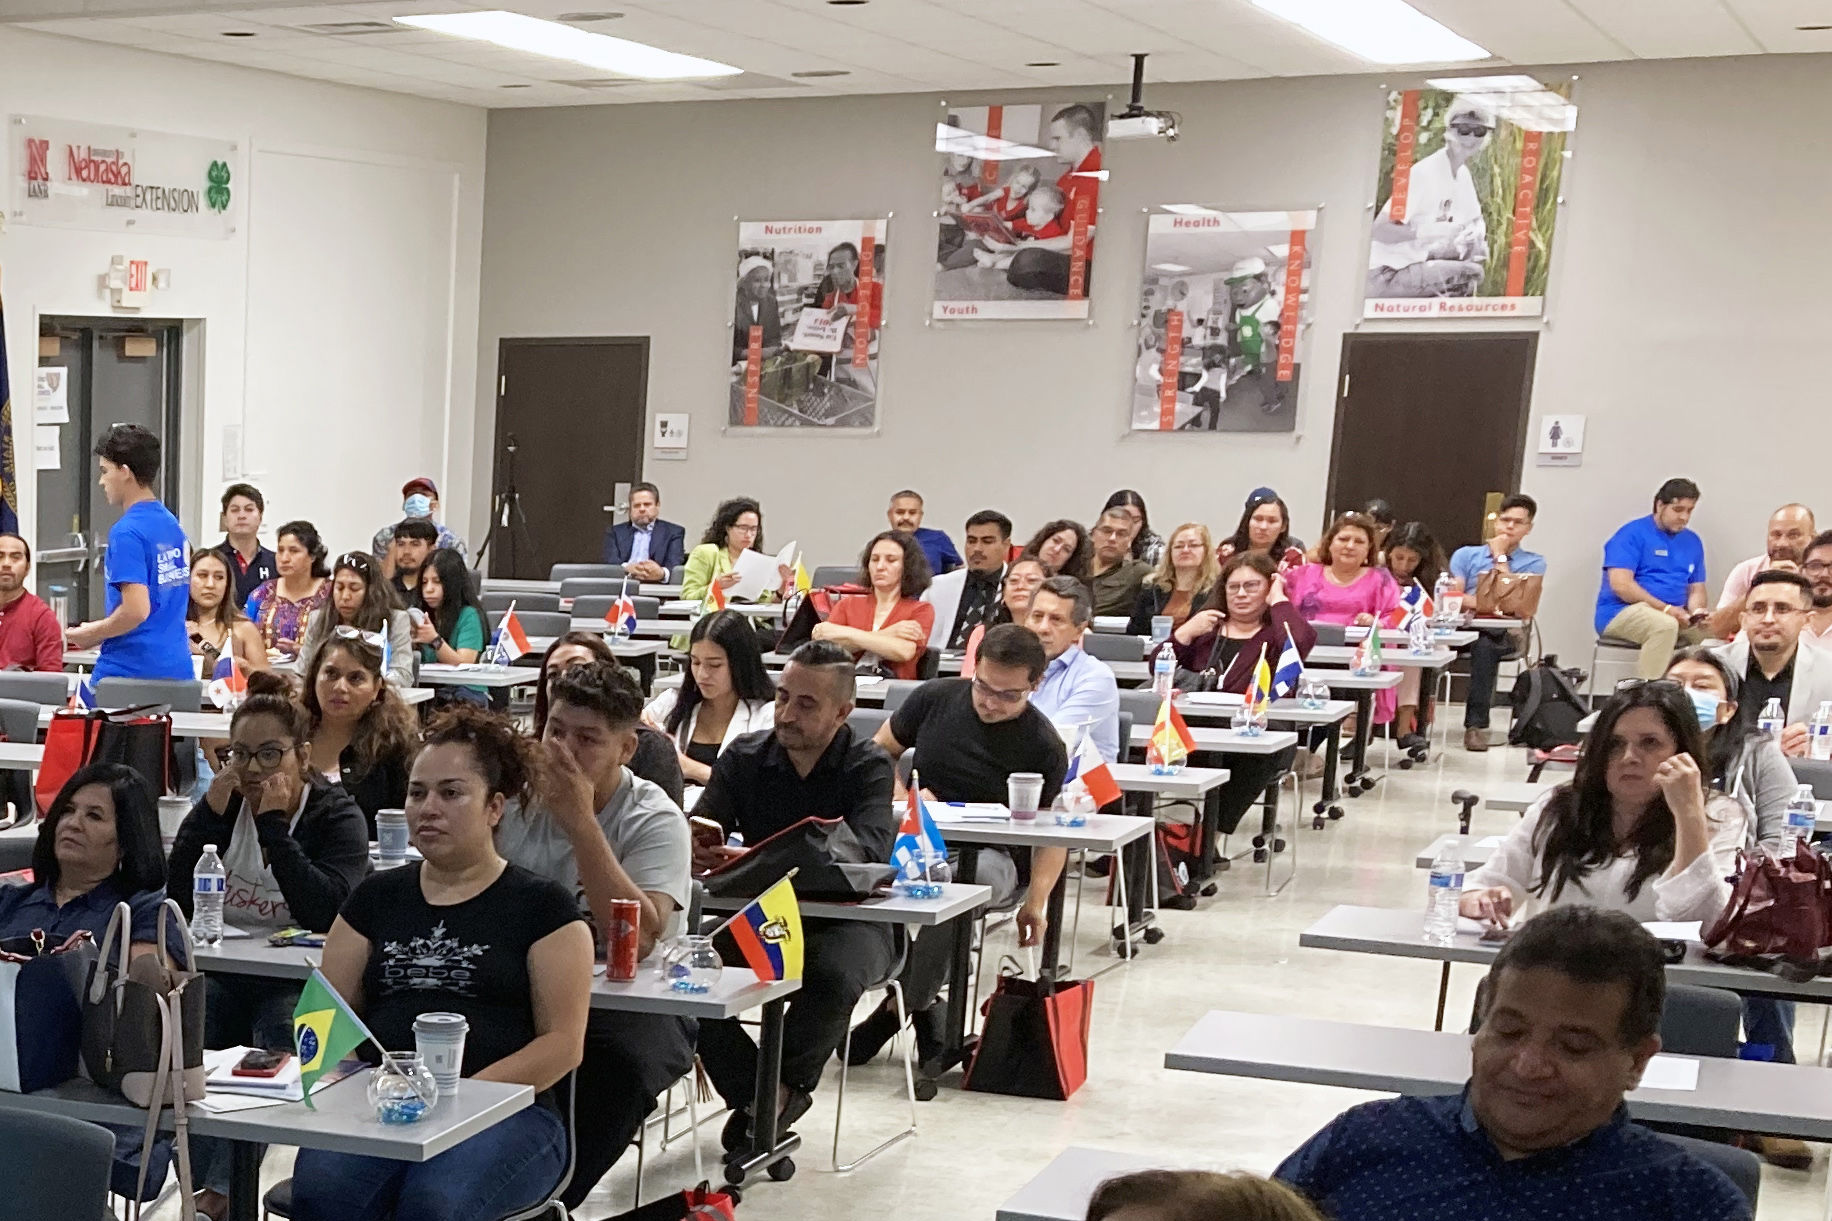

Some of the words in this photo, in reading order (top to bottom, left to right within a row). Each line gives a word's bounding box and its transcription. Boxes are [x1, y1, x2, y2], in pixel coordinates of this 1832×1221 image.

[27, 138, 49, 181] N
[66, 144, 132, 186] Nebraska
[1391, 118, 1413, 215] DEVELOP
[134, 184, 200, 213] EXTENSION
[764, 225, 823, 235] Nutrition
[1173, 217, 1221, 228] Health
[1071, 199, 1089, 296] GUIDANCE
[129, 260, 148, 292] EXIT
[855, 251, 873, 365] DIRECTION
[942, 305, 979, 315] Youth
[1278, 245, 1304, 379] KNOWLEDGE
[1374, 302, 1432, 312] Natural
[1439, 301, 1517, 313] Resources
[746, 329, 762, 408] INSPIRE
[1162, 314, 1183, 424] STRENGTH
[259, 566, 269, 579] H
[384, 965, 472, 980] bebe
